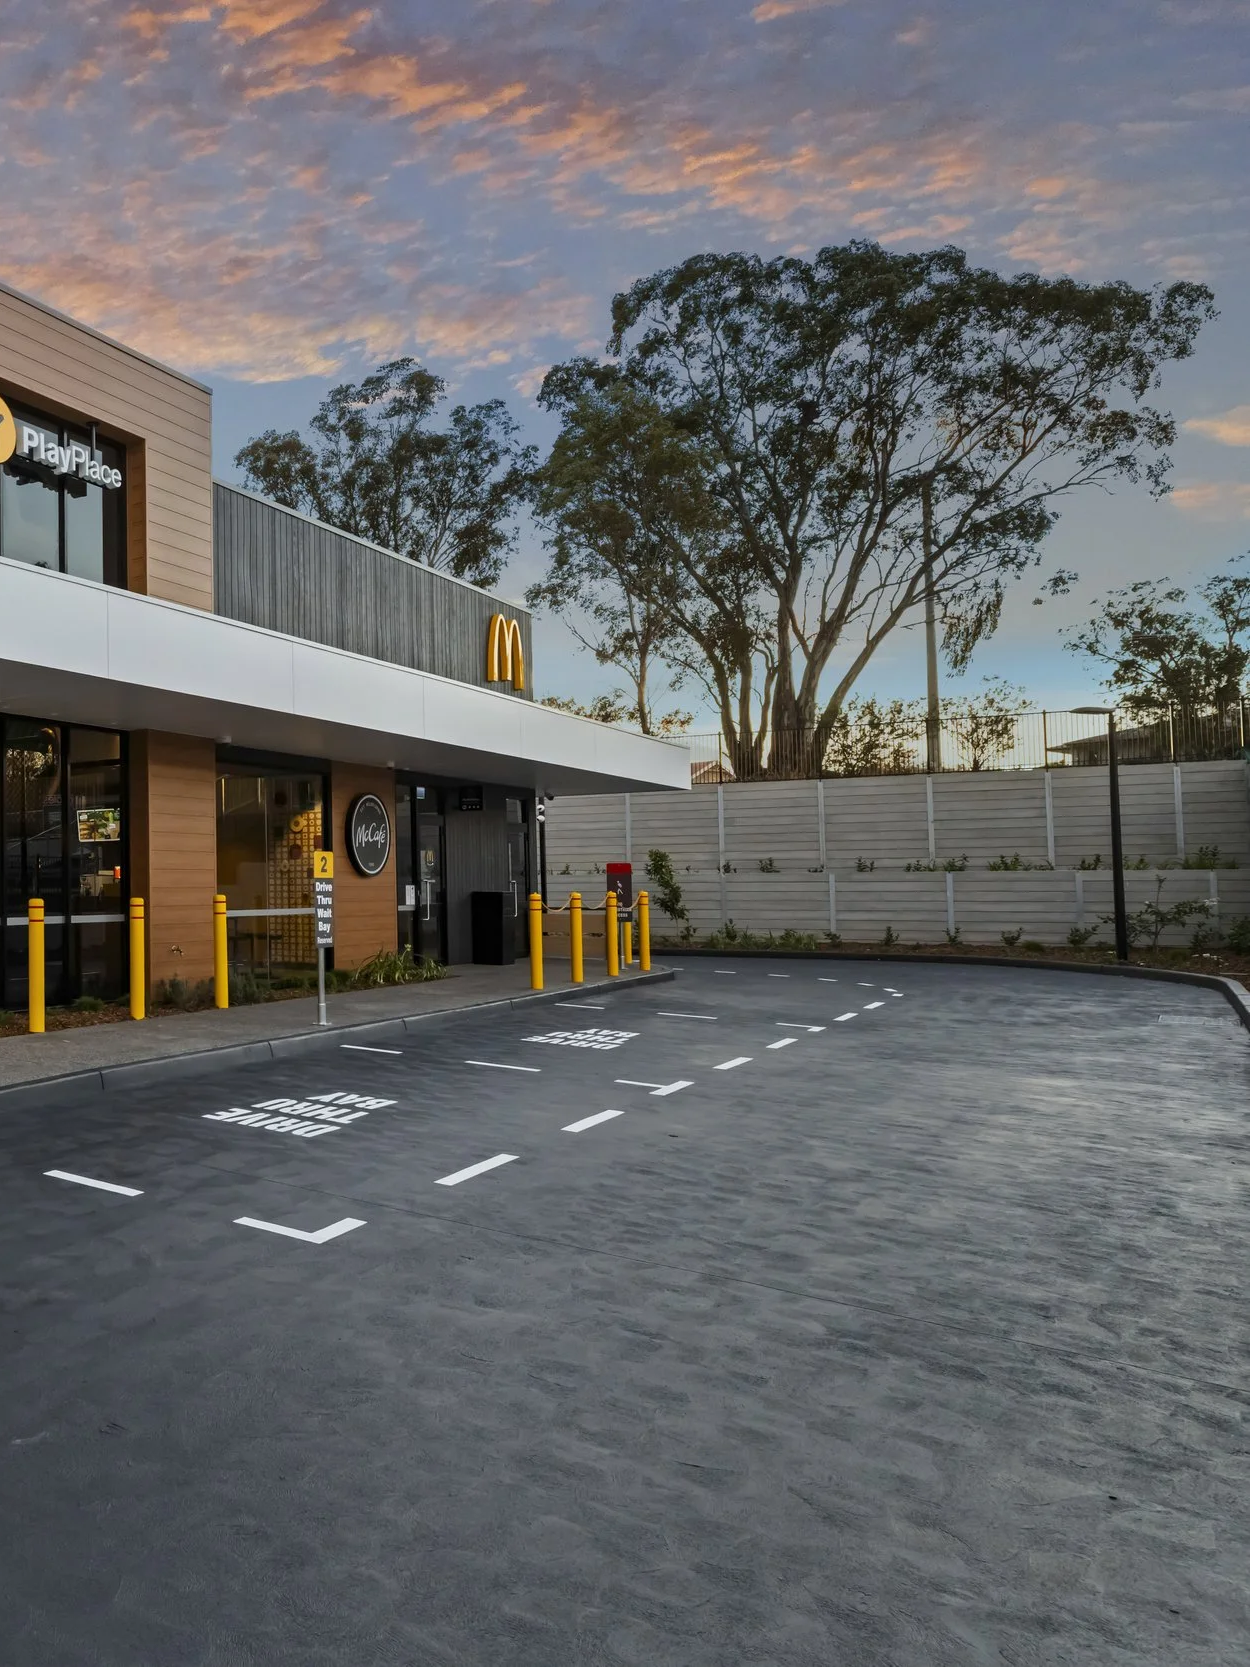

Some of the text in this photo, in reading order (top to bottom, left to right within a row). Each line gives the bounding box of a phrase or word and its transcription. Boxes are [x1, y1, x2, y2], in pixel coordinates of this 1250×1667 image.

[17, 426, 122, 489] PlayPlace
[355, 822, 386, 849] McCafé
[320, 856, 328, 873] 2
[315, 882, 333, 892] Drive
[316, 895, 333, 905] Thru
[316, 908, 332, 918] Wait
[318, 921, 331, 933] Bay
[520, 1035, 621, 1050] DRIVE
[304, 1091, 399, 1110] BAY
[251, 1098, 370, 1124] THRU
[201, 1107, 342, 1138] DRIVE
